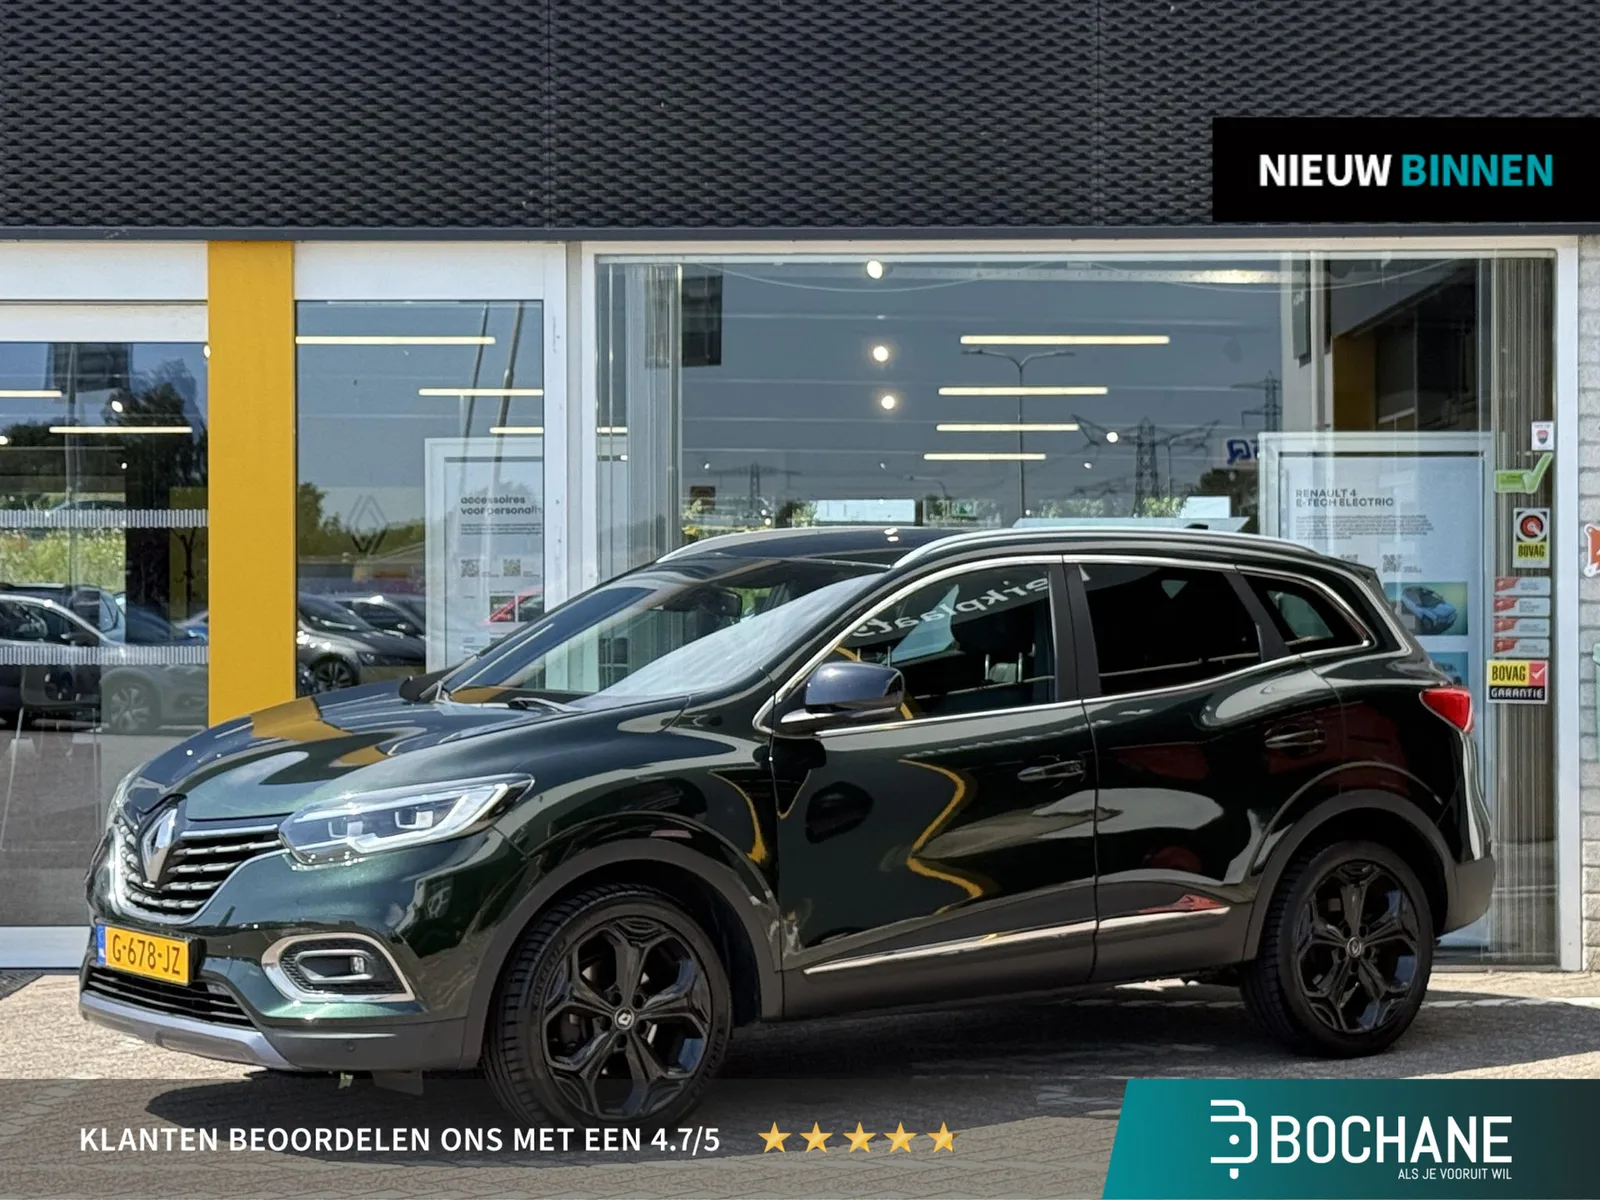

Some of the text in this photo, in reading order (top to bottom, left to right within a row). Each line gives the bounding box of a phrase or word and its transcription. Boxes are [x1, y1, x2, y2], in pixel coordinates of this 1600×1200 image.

[1296, 488, 1357, 498] RENAULT 4
[1296, 498, 1394, 508] E-TECH ELECTRIC
[460, 506, 486, 516] voor
[1517, 544, 1545, 558] BOVAG
[1491, 665, 1526, 681] BOVAG
[1491, 687, 1544, 699] GARANTIE
[112, 933, 181, 976] G-678-JZ
